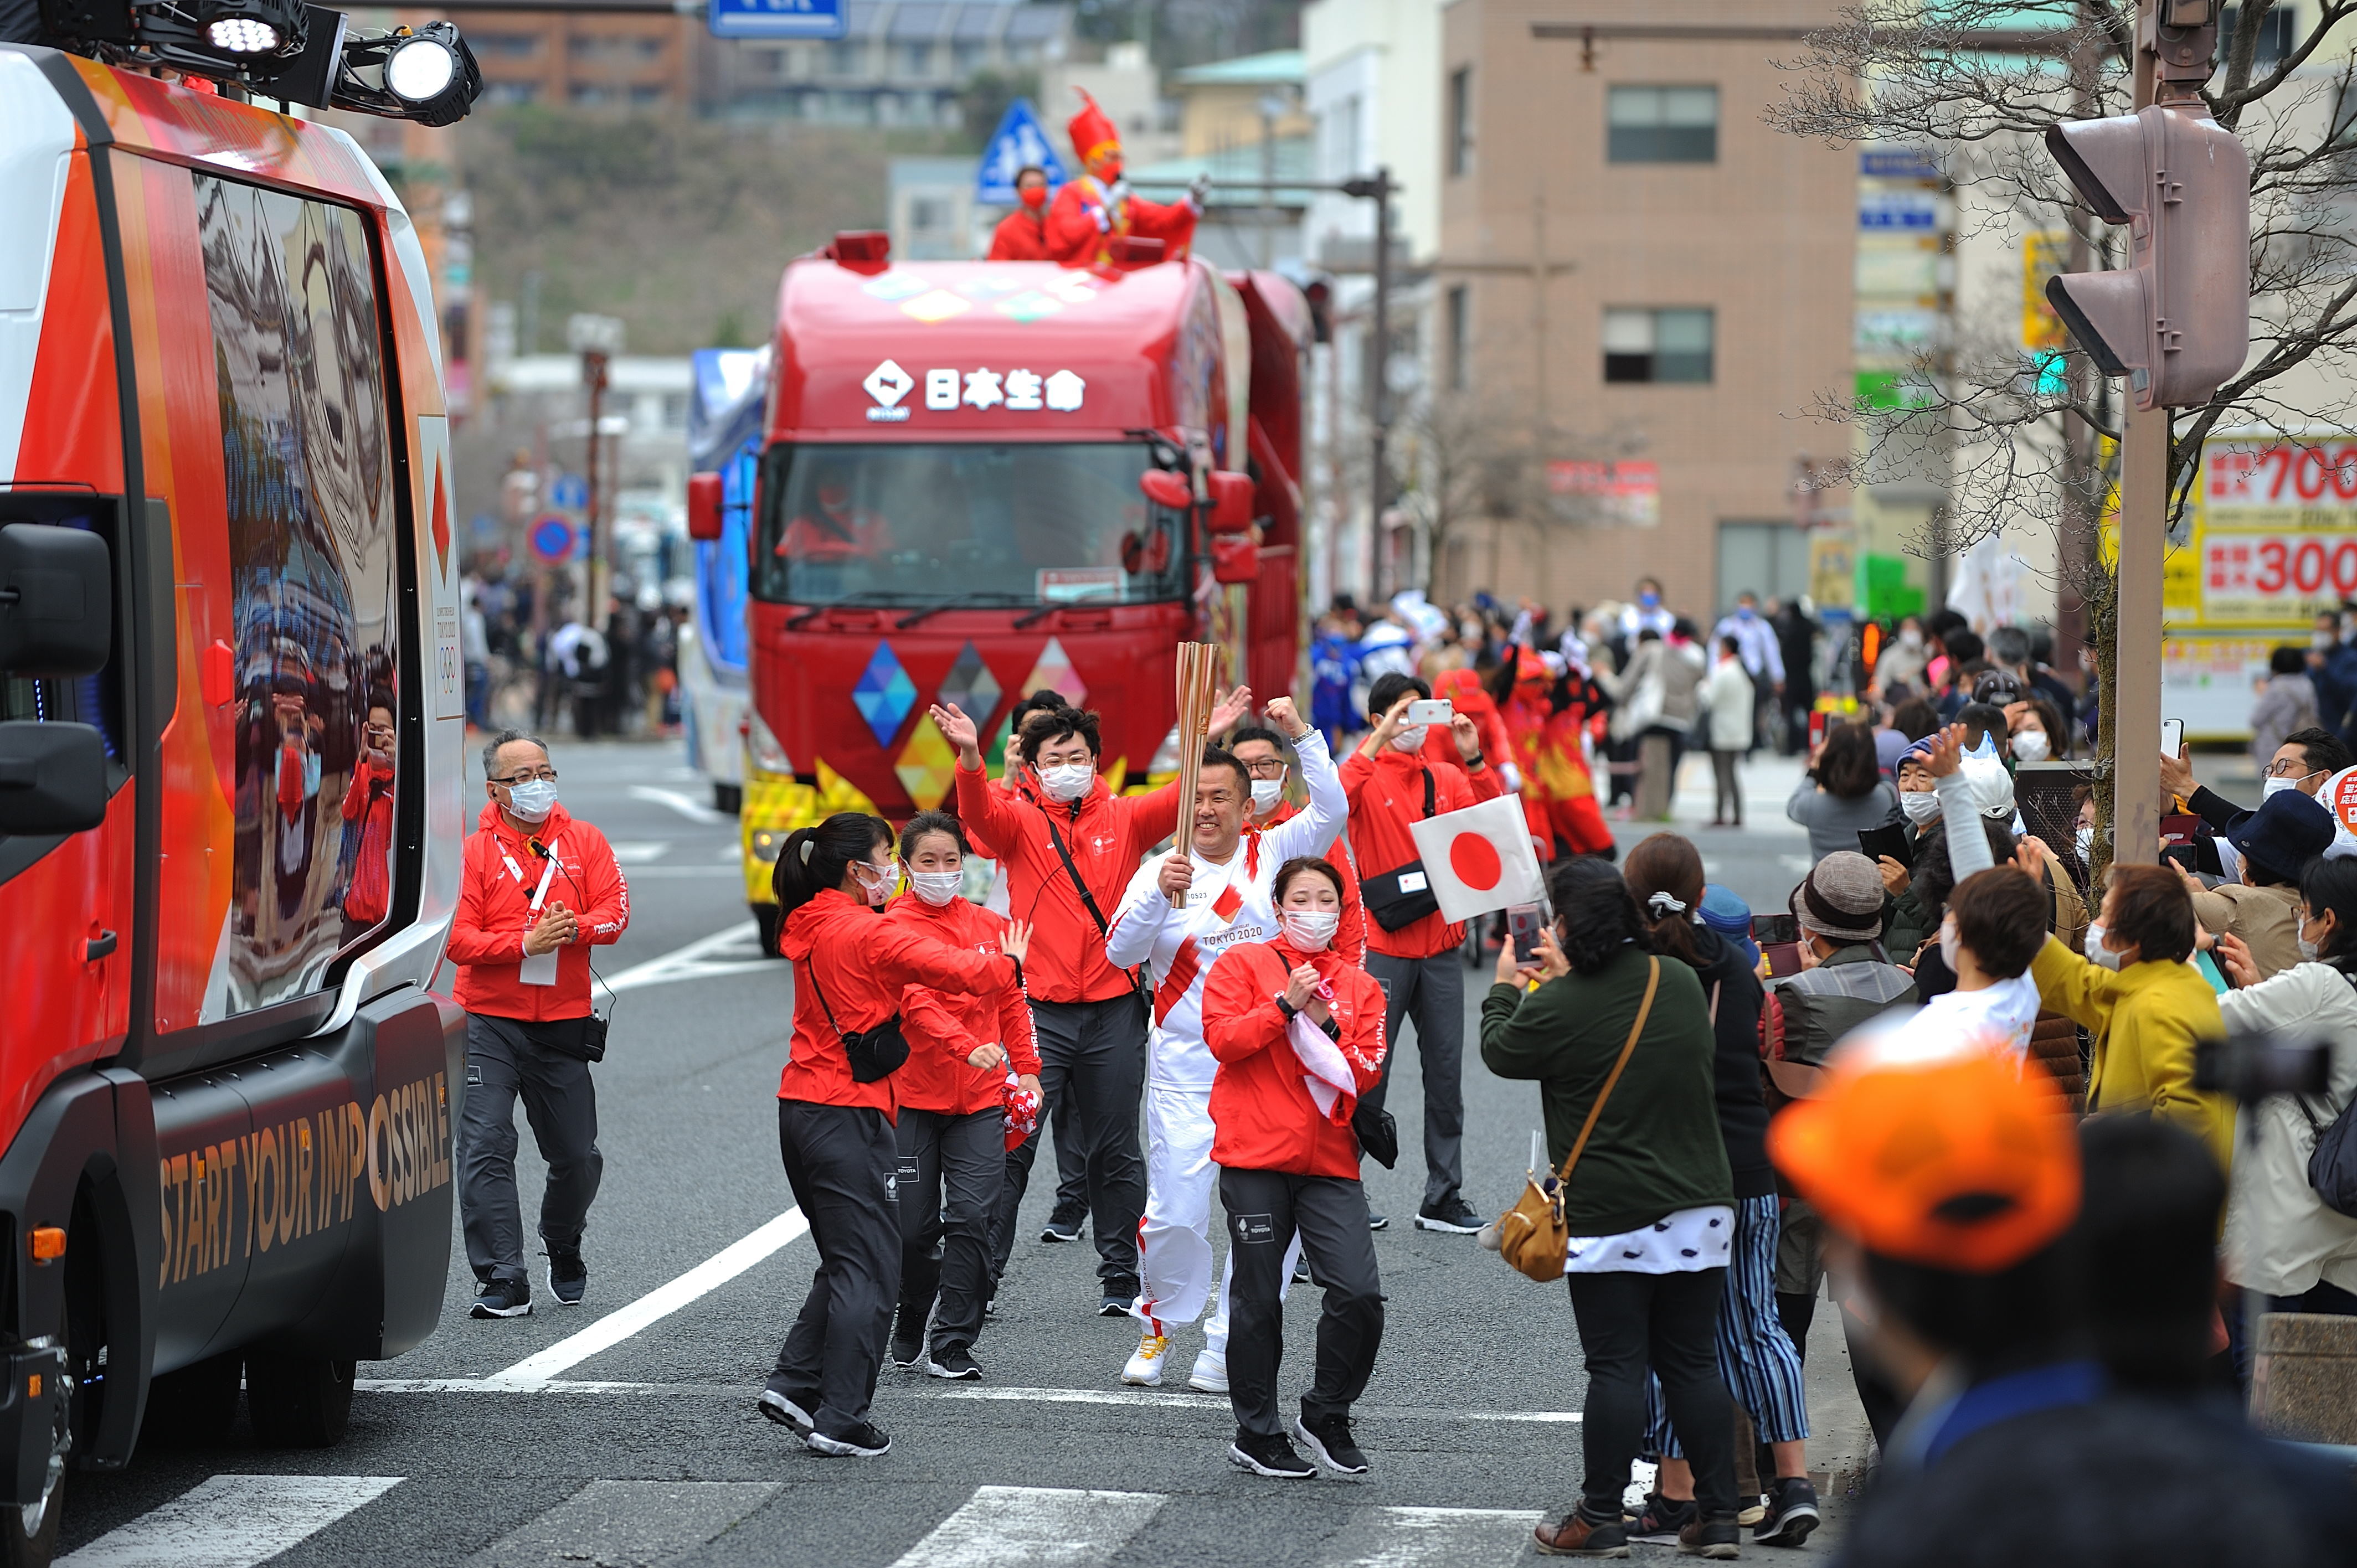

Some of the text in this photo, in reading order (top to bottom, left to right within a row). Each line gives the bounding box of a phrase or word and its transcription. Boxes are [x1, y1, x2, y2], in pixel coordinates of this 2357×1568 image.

[925, 367, 1085, 412] 日本生命
[2256, 540, 2357, 592] 300
[1203, 927, 1262, 946] TOKYO 2020
[159, 1071, 449, 1291] START YOUR IMPOSSIBLE
[1144, 1282, 1154, 1297] 2020
